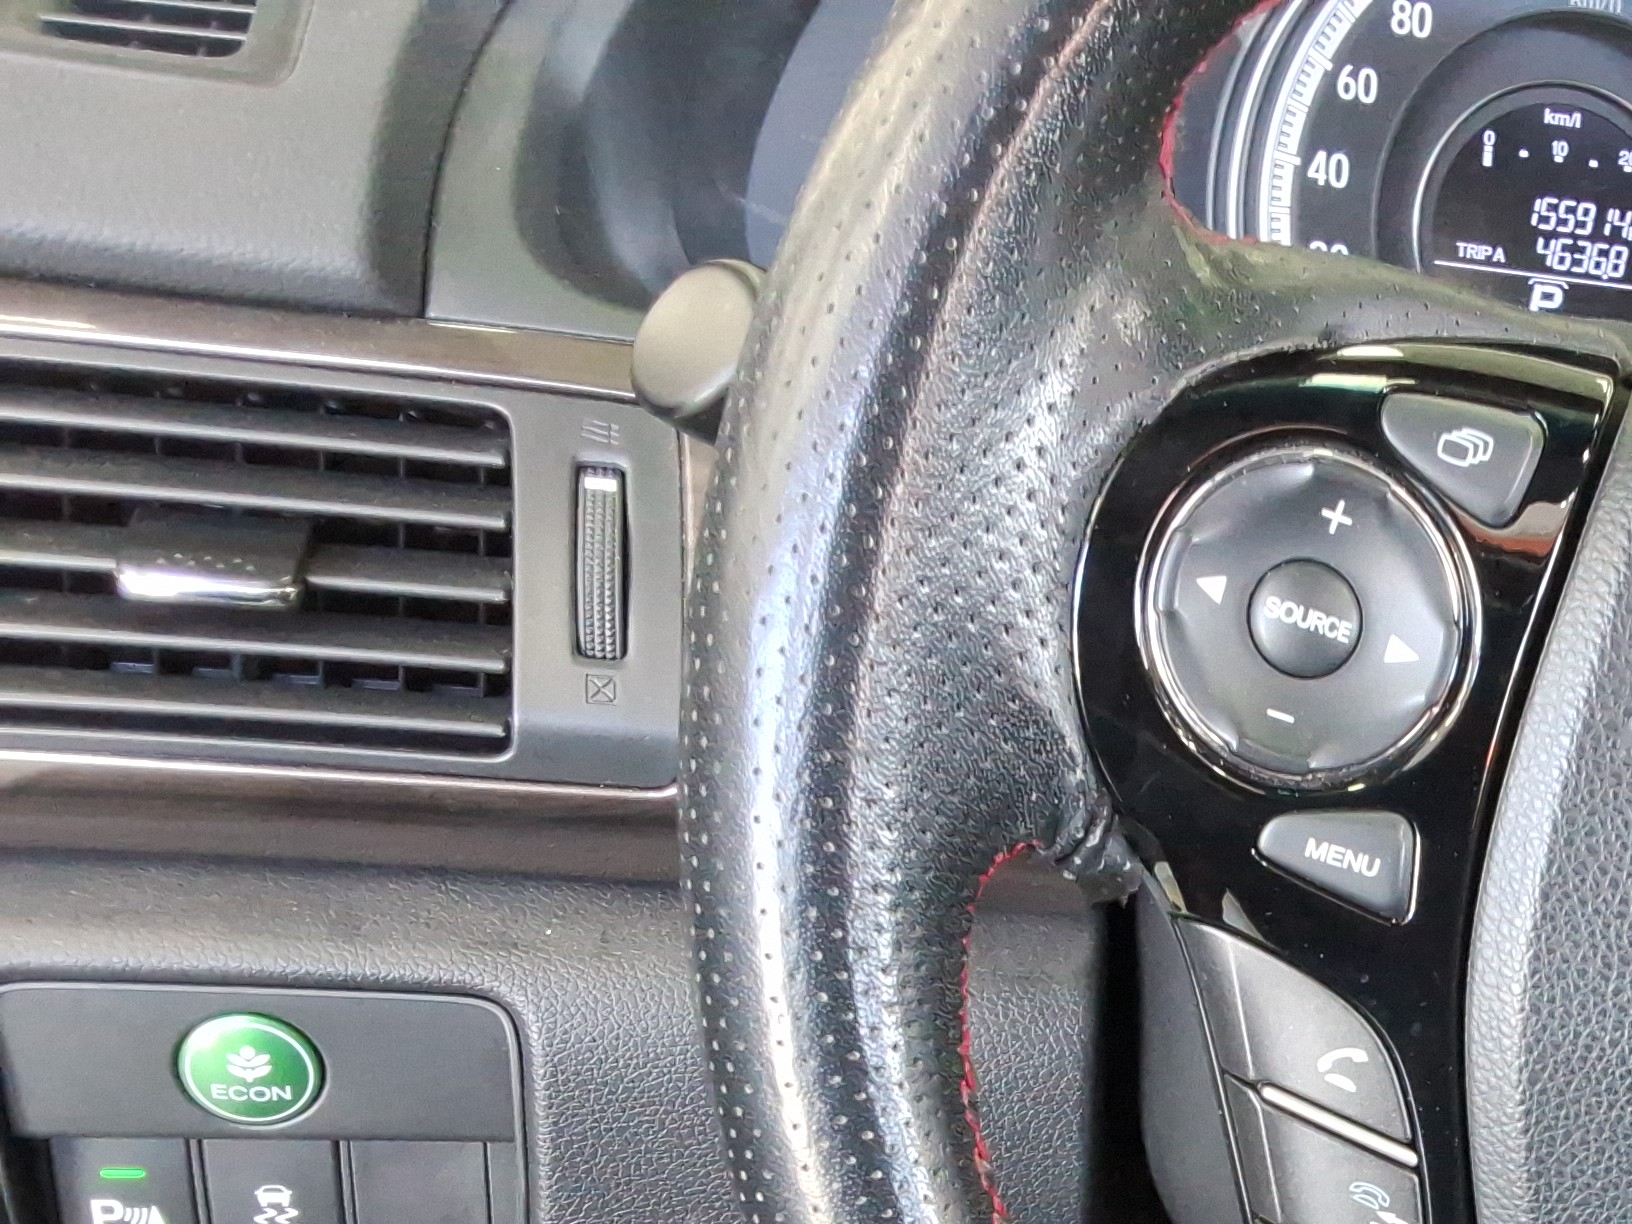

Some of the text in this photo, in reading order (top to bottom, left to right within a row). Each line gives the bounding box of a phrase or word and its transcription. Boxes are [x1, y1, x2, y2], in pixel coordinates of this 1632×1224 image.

[1390, 0, 1432, 38] 80
[1336, 65, 1378, 104] 60
[1552, 141, 1569, 157] 10
[1307, 150, 1349, 190] 40
[1528, 284, 1565, 312] P
[1263, 595, 1352, 644] SOURCE
[1305, 837, 1381, 878] MENU
[210, 1083, 292, 1102] ECON
